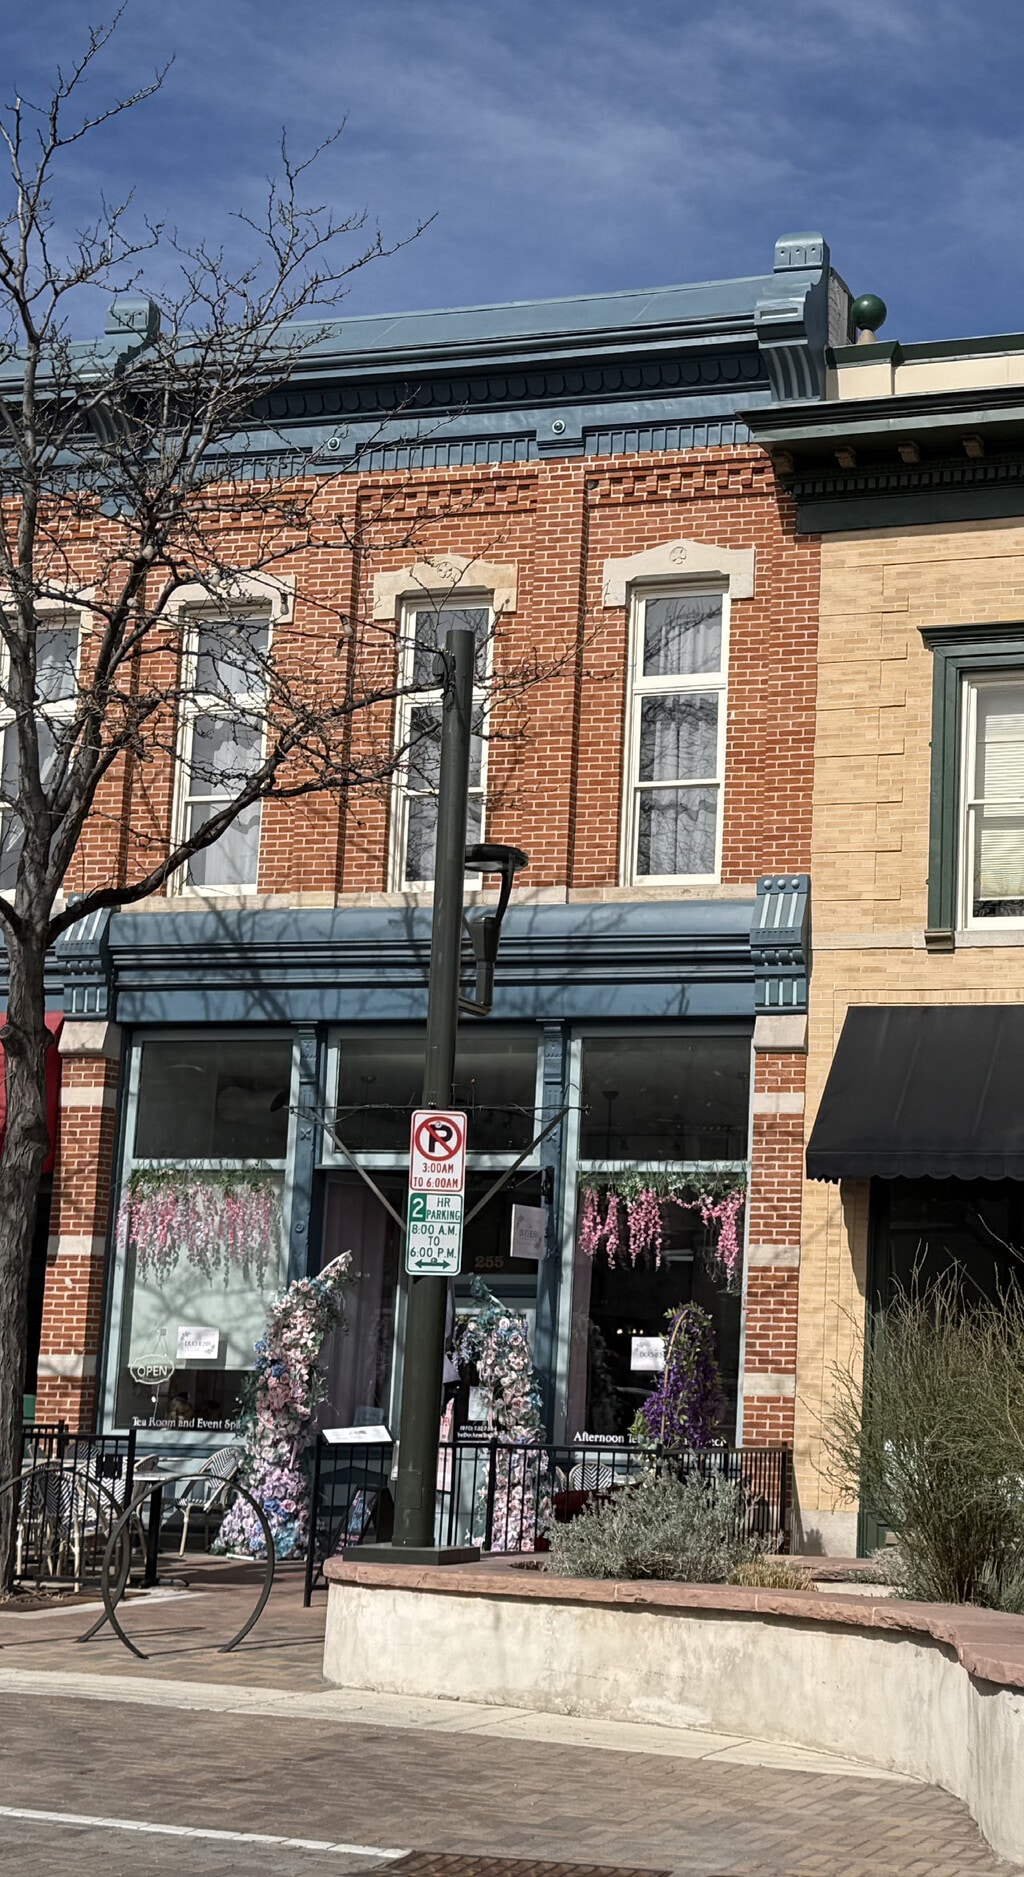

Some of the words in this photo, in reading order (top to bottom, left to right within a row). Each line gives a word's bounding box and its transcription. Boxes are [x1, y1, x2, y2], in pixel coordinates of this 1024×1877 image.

[422, 1162, 454, 1174] 3:00AM
[413, 1176, 424, 1187] TO
[412, 1198, 424, 1218] 2
[436, 1197, 451, 1208] HR
[426, 1209, 461, 1221] PARKING
[411, 1224, 435, 1235] 8:00
[438, 1225, 458, 1236] A.M.
[428, 1236, 441, 1246] TO
[410, 1247, 433, 1258] 6:00
[437, 1248, 457, 1259] P.M.
[474, 1255, 505, 1269] 255
[137, 1365, 168, 1377] OPEN
[131, 1416, 147, 1427] Tea
[148, 1416, 176, 1428] Room
[178, 1417, 195, 1428] and
[197, 1417, 222, 1429] Event
[573, 1431, 625, 1444] Afternoon
